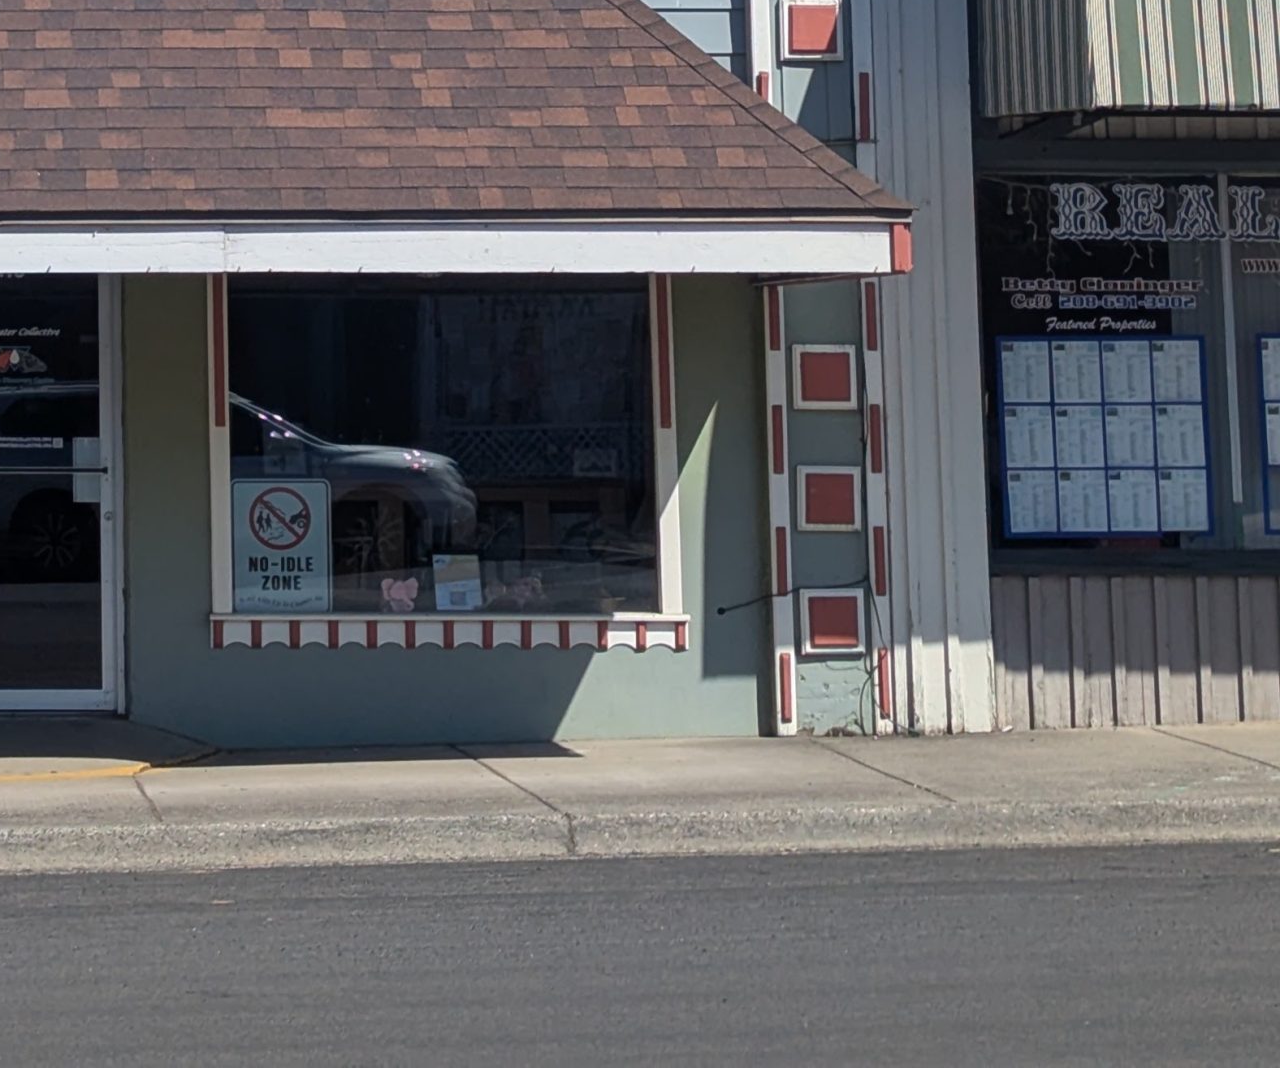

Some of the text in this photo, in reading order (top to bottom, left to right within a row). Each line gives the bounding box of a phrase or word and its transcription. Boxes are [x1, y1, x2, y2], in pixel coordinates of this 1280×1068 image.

[1049, 182, 1280, 241] REAL
[1001, 276, 1076, 294] Betty
[1058, 293, 1197, 310] 208-691-3902
[1045, 316, 1157, 332] Featured Properties
[248, 556, 314, 572] NO-IDLE
[261, 575, 302, 590] ZONE
